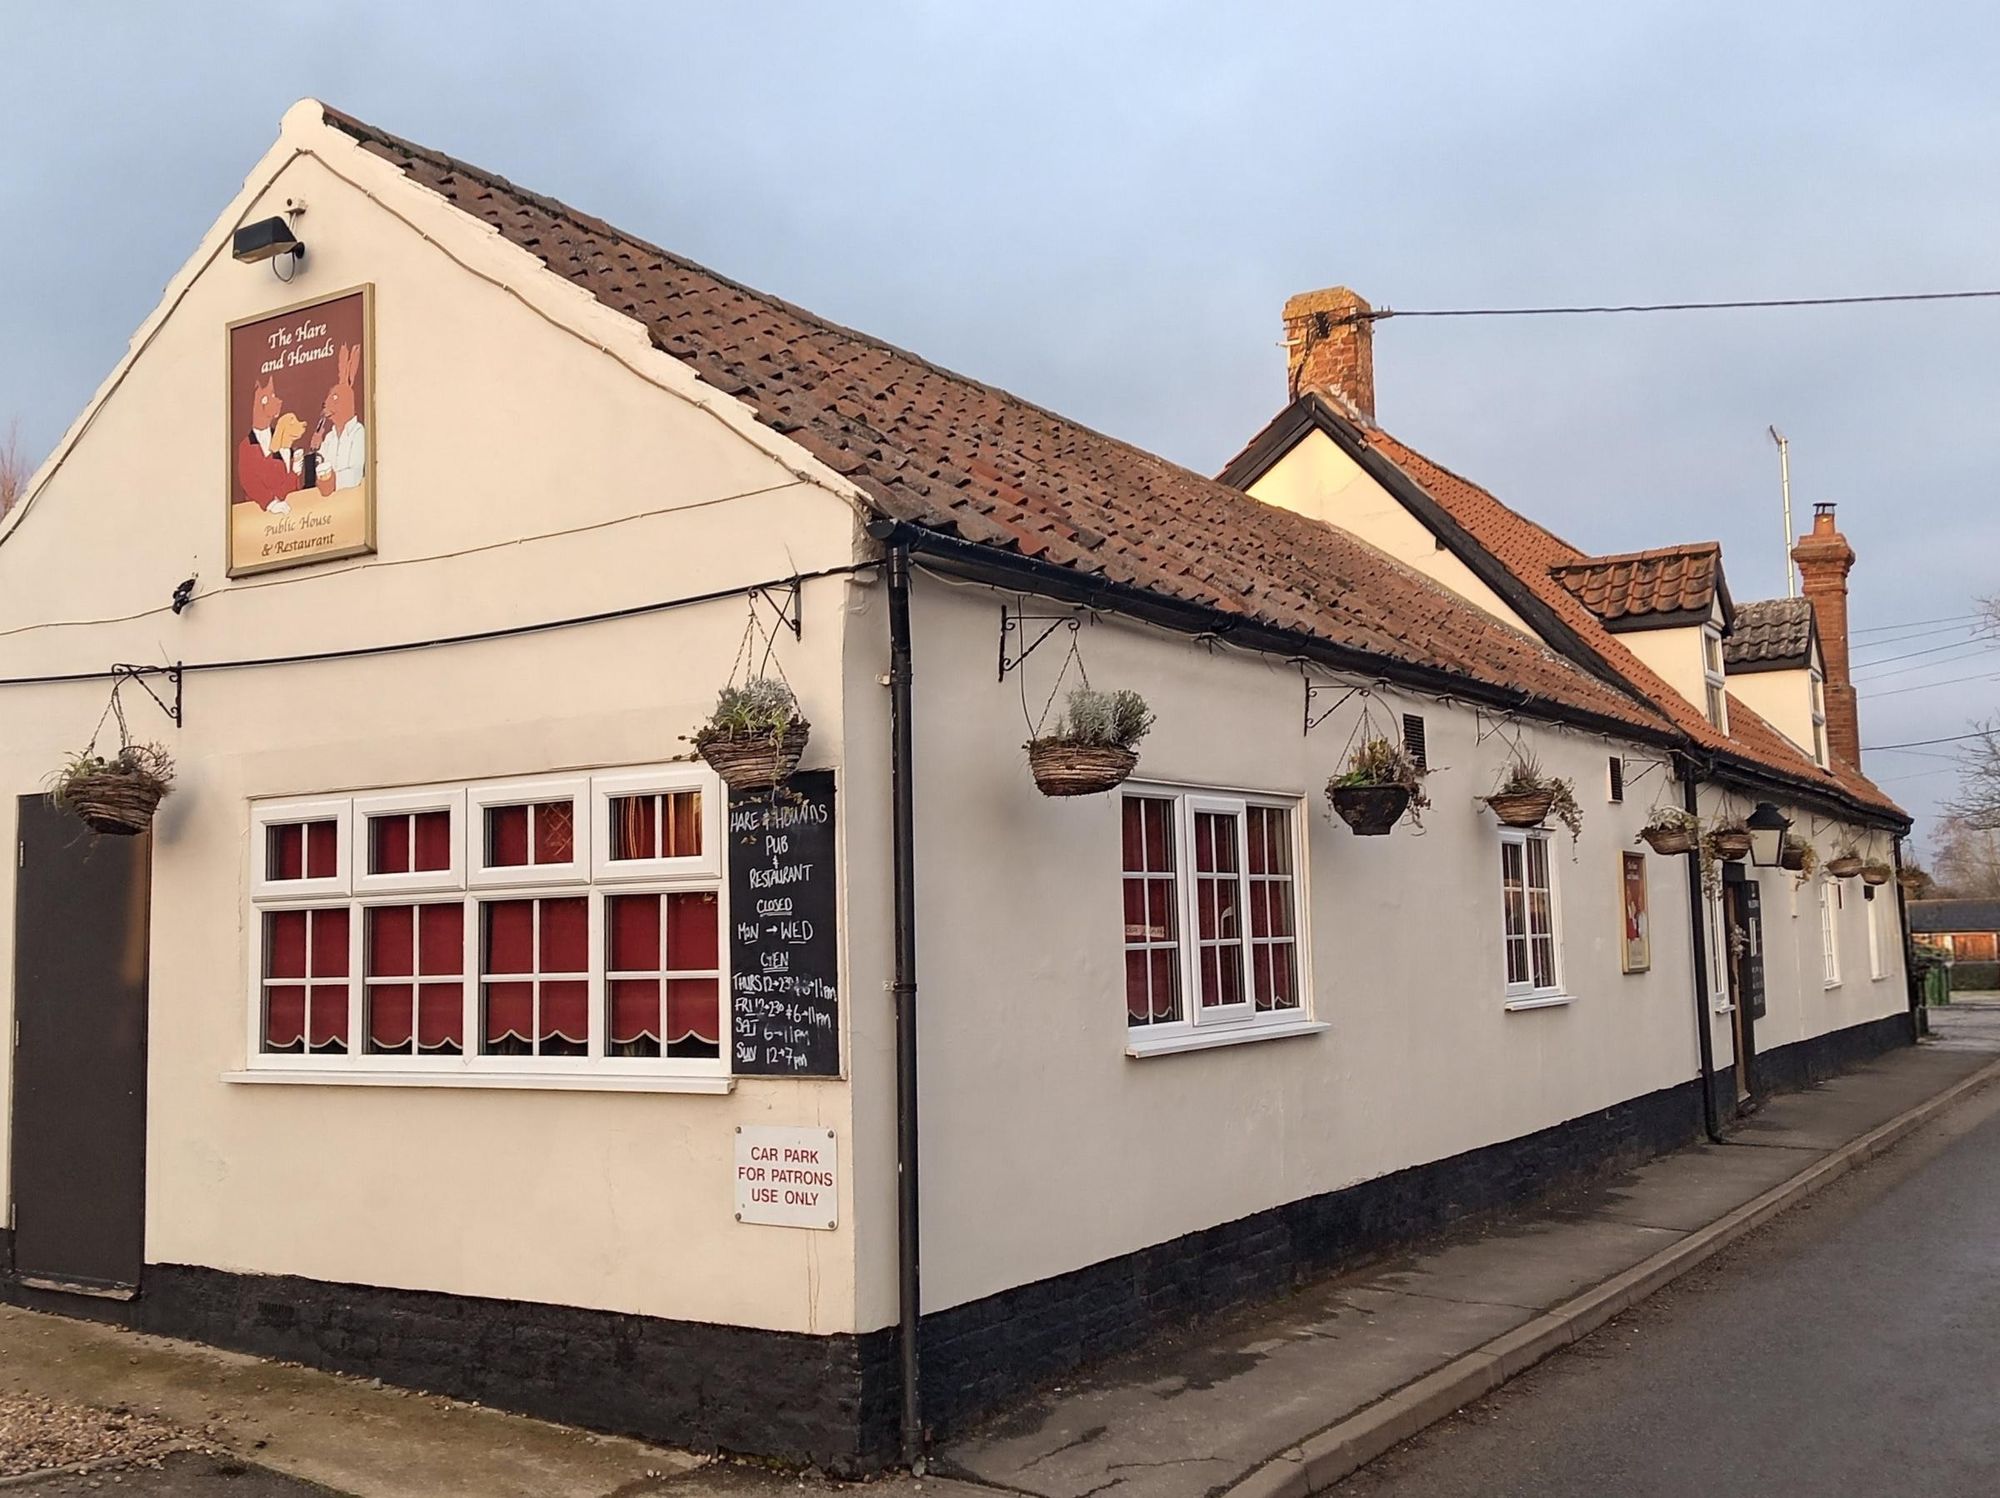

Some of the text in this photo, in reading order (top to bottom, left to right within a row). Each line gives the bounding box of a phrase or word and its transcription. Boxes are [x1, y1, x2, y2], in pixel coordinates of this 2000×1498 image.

[268, 320, 327, 350] The Hare
[261, 338, 334, 373] and Hounds
[264, 512, 332, 536] Public House
[261, 533, 335, 558] & Restaurant
[730, 811, 760, 833] HARE
[775, 804, 828, 829] HOUNDS
[765, 835, 789, 856] PUB
[749, 864, 813, 889] RESTAURANT
[756, 897, 793, 914] CLOSED
[737, 920, 814, 940] MON WED
[732, 972, 762, 992] THURS
[735, 997, 753, 1013] FRI
[735, 1017, 760, 1035] SAT
[736, 1042, 757, 1060] SUN
[751, 1146, 819, 1164] CAR PARK
[738, 1166, 833, 1187] FOR PATRONS
[751, 1188, 819, 1206] USE ONLY
